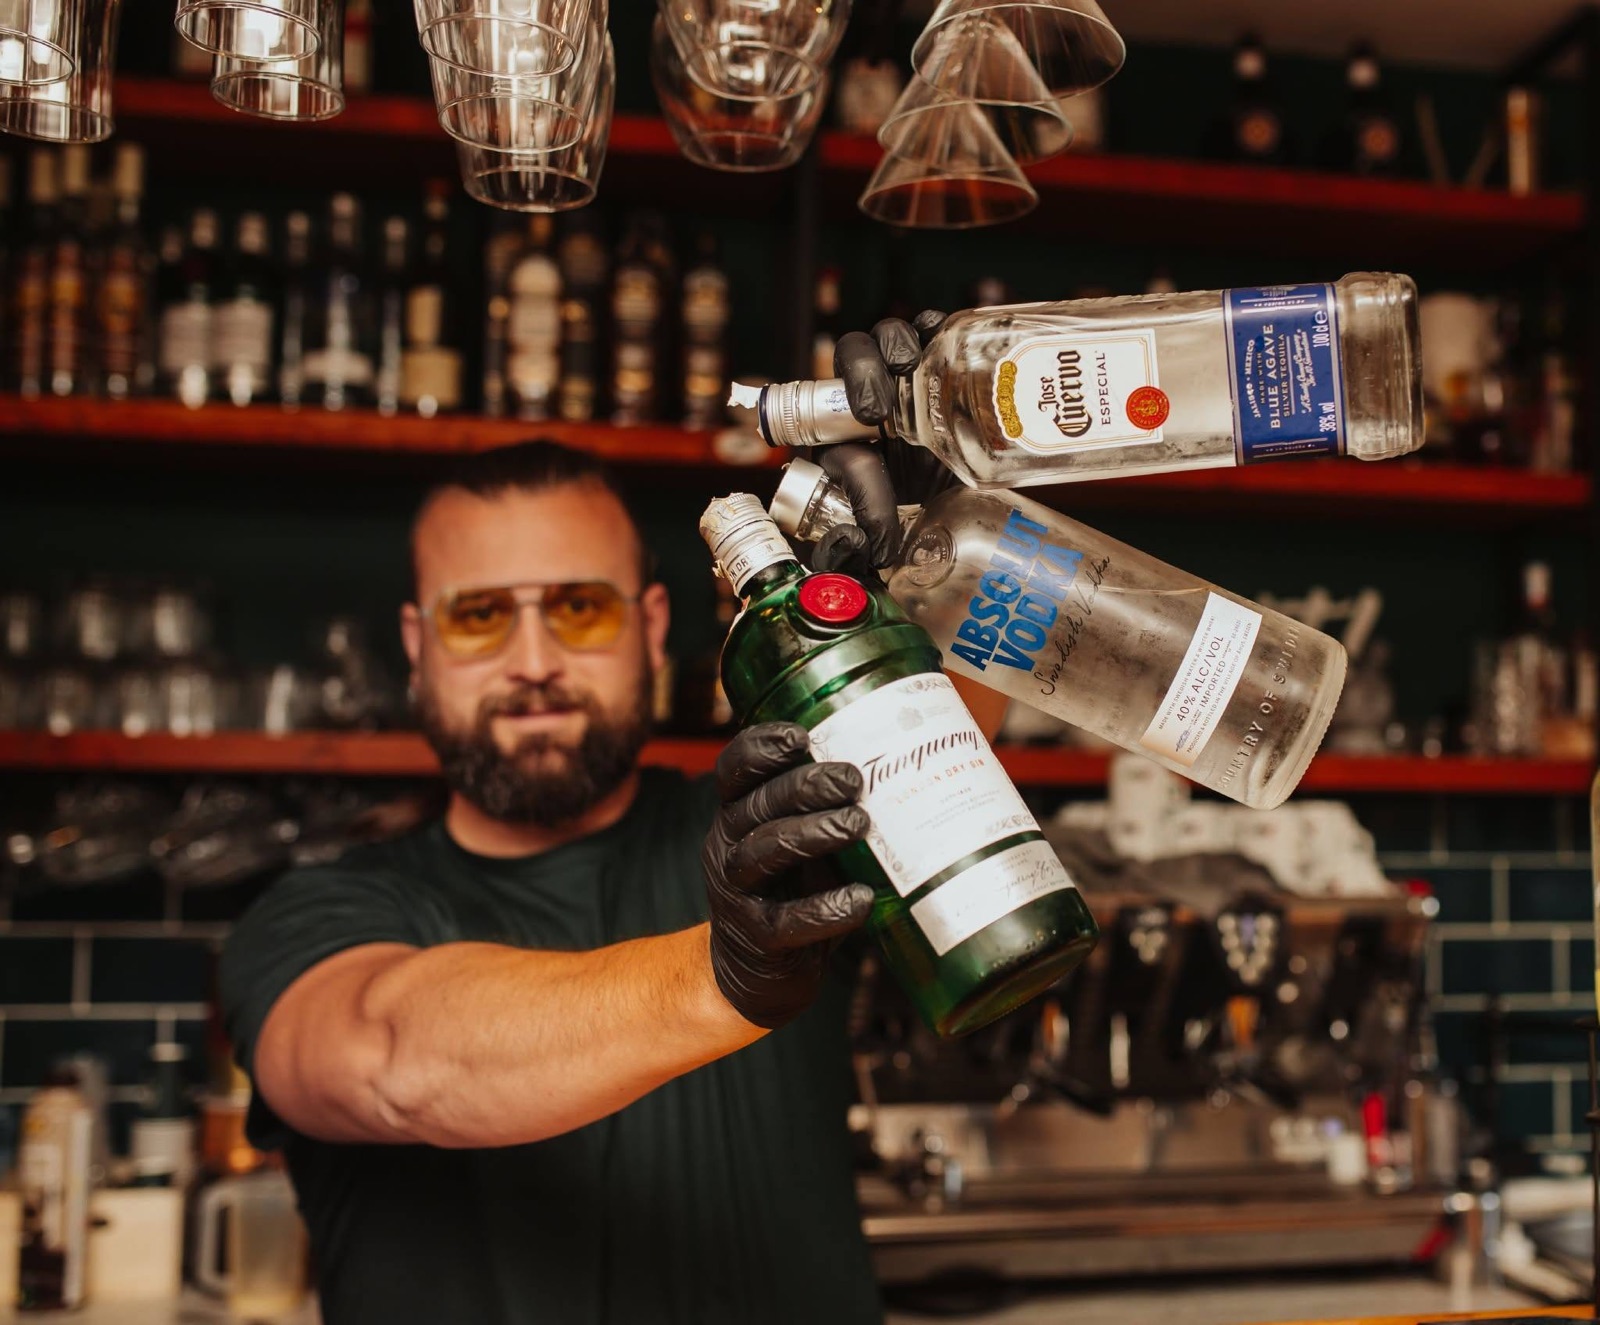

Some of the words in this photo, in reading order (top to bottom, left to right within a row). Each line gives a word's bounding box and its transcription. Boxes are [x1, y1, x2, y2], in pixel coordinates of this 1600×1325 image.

[1244, 339, 1256, 375] MEXICO
[1263, 324, 1278, 380] AGAVE
[1278, 334, 1287, 379] TEQUILA
[1312, 334, 1330, 348] 100
[1038, 376, 1059, 412] Jose
[1053, 350, 1092, 437] Cuervo
[1096, 352, 1111, 425] ESPECIAL
[1268, 386, 1280, 429] BLUE
[1281, 381, 1291, 417] SILVER
[1318, 402, 1335, 415] vol
[1319, 414, 1336, 433] 38%
[950, 508, 1048, 672] ABSOLUT
[992, 544, 1084, 672] VODKA
[1033, 614, 1083, 695] Swedish
[1075, 555, 1110, 616] Vodka
[1176, 696, 1196, 721] 40%
[1191, 636, 1224, 693] ALC/VOL
[1199, 660, 1226, 708] IMPORTED
[1259, 690, 1278, 714] OF
[1158, 716, 1168, 730] MADE
[1166, 703, 1176, 716] WITH
[1173, 677, 1189, 703] SWEDISH
[1186, 731, 1202, 753] PRODUCED
[1203, 705, 1217, 727] BOTTLED
[1218, 686, 1226, 697] THE
[862, 729, 978, 795] Tanqueray
[945, 764, 965, 777] DRY
[969, 758, 984, 769] GIN
